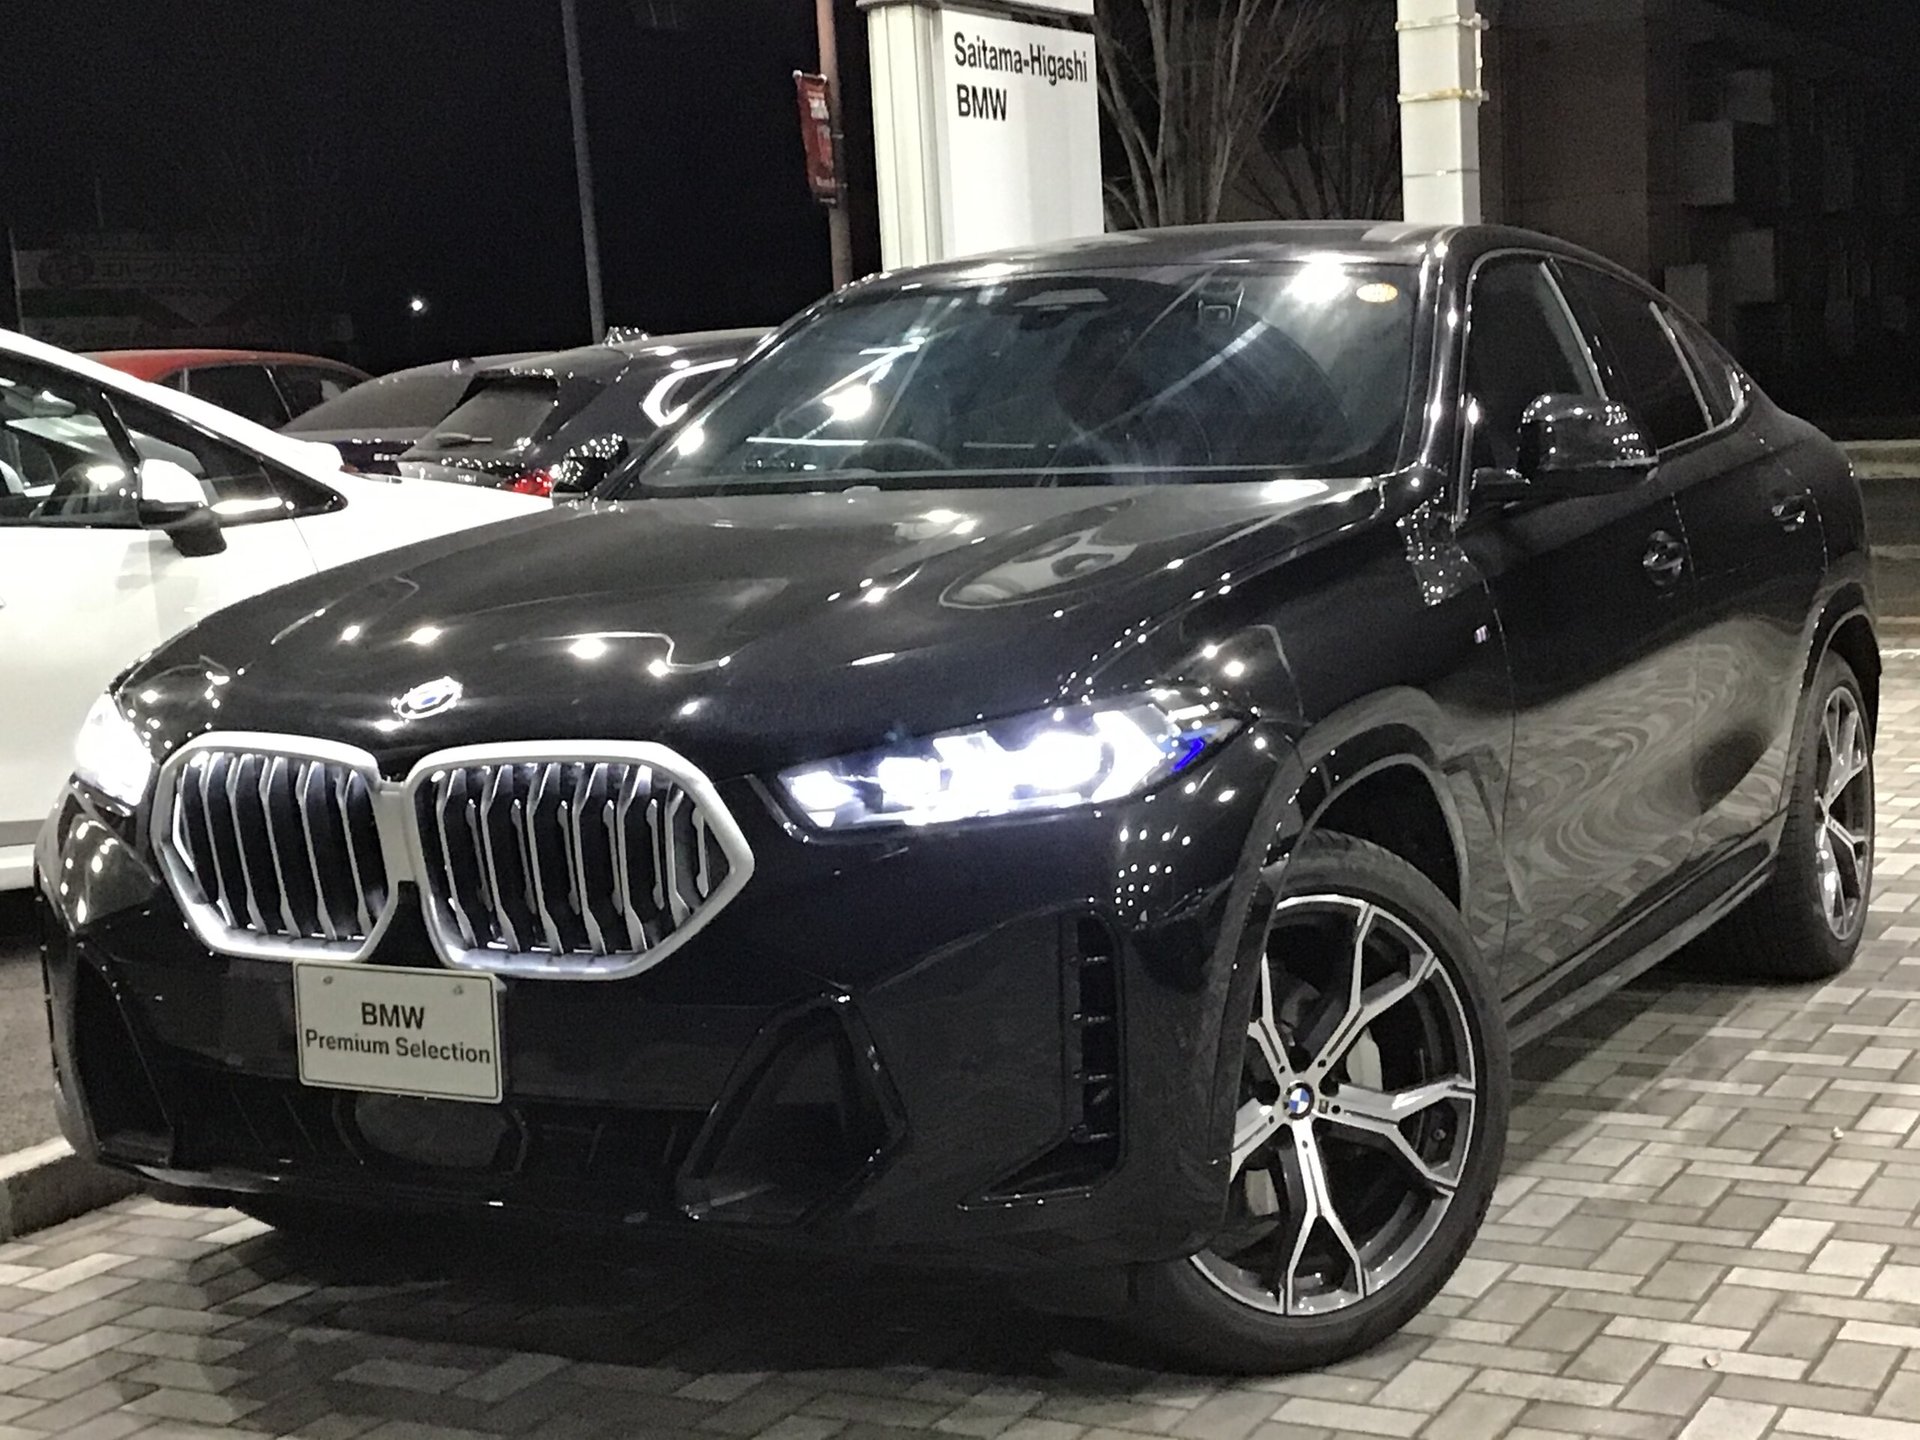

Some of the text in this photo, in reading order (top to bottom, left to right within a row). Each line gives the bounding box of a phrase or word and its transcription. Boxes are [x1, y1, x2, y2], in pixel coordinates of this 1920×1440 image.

[953, 31, 1088, 86] Saitama-Higashi
[956, 84, 1008, 121] BMW
[361, 1002, 425, 1029] BMW
[305, 1029, 491, 1064] Premium Selection
